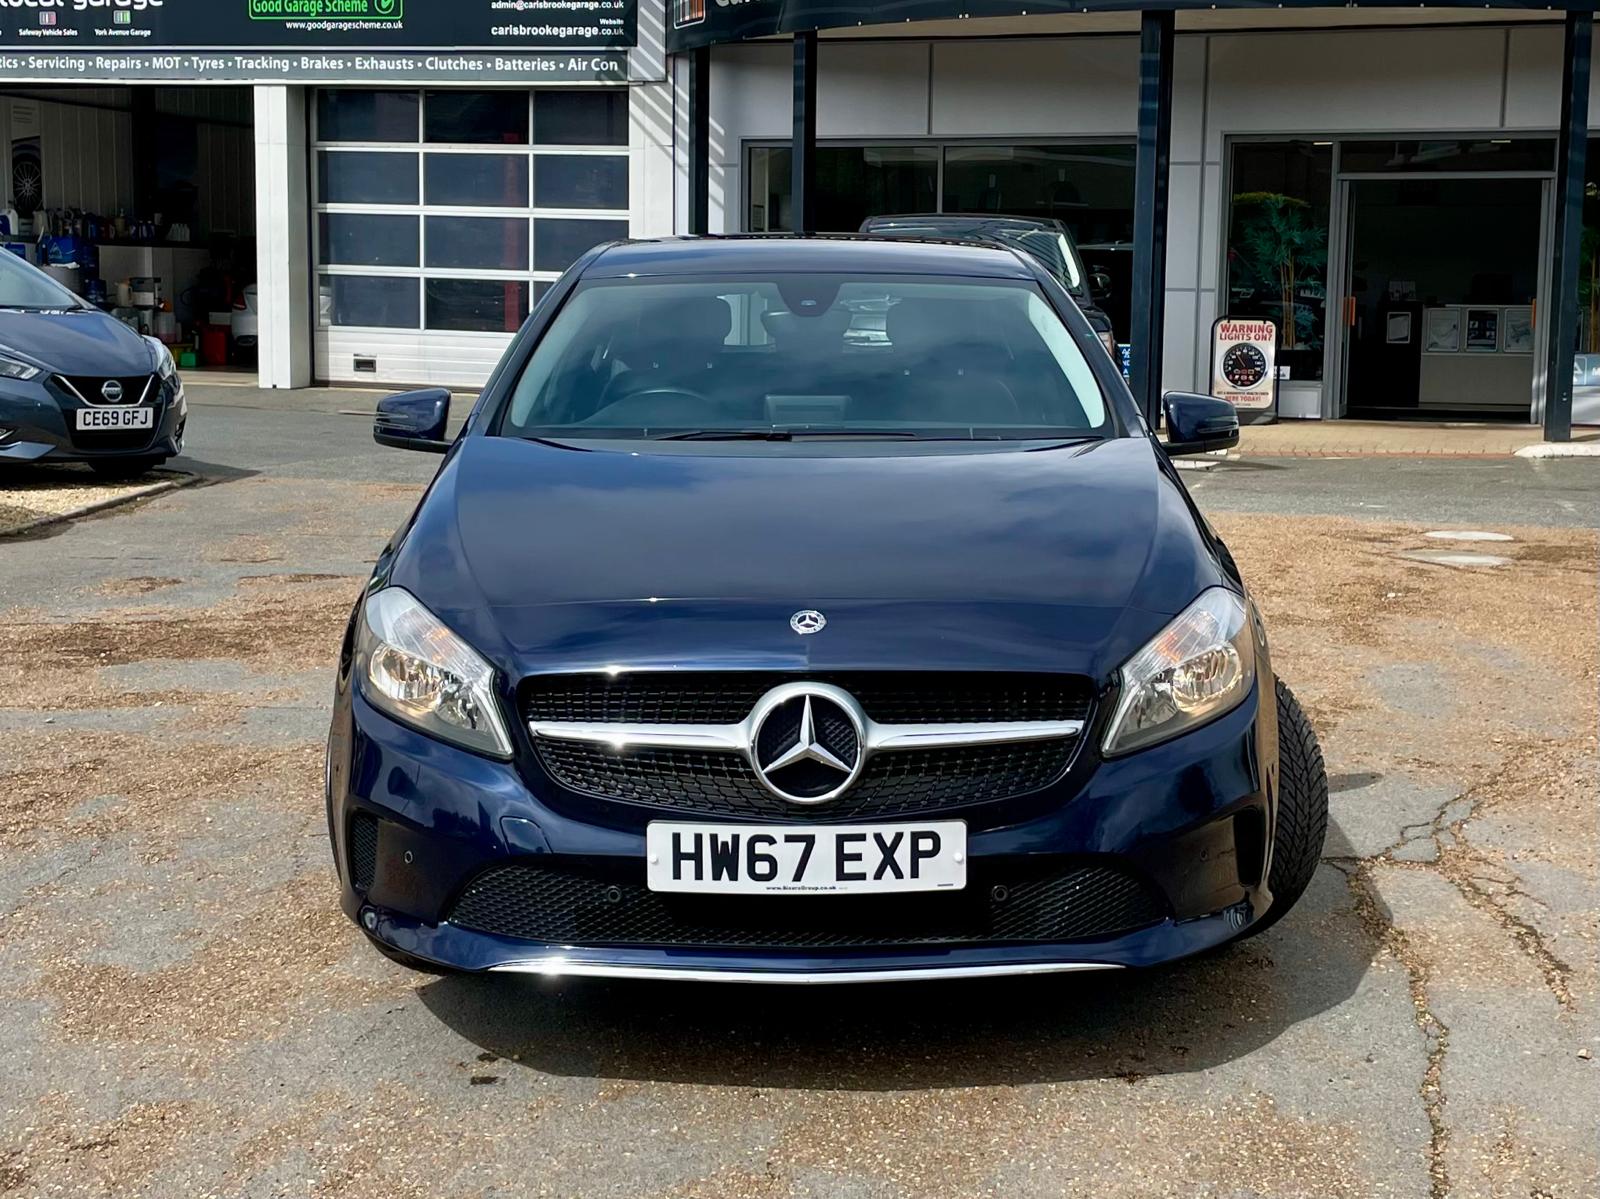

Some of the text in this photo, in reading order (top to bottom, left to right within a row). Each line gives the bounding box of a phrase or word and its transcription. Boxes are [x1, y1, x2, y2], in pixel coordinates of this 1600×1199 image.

[253, 0, 368, 16] Good Garage Scheme
[286, 20, 403, 31] www.goodgaragescheme.co.uk
[19, 28, 78, 37] Safeway Vehicle Sales
[94, 28, 151, 37] York Avenue Garage
[28, 56, 85, 71] Servicing
[96, 57, 142, 71] Repairs
[152, 57, 182, 70] MOT
[191, 57, 225, 72] Tyres
[235, 56, 289, 72] Tracking
[301, 57, 344, 70] Brakes
[355, 57, 414, 70] Exhausts
[425, 57, 483, 70] Clutches
[495, 58, 556, 71] Batteries
[568, 58, 587, 71] Air
[590, 58, 618, 71] Con
[1220, 324, 1273, 333] WARNING
[83, 410, 148, 426] CE69 GFJ
[672, 831, 941, 882] HW67 EXP
